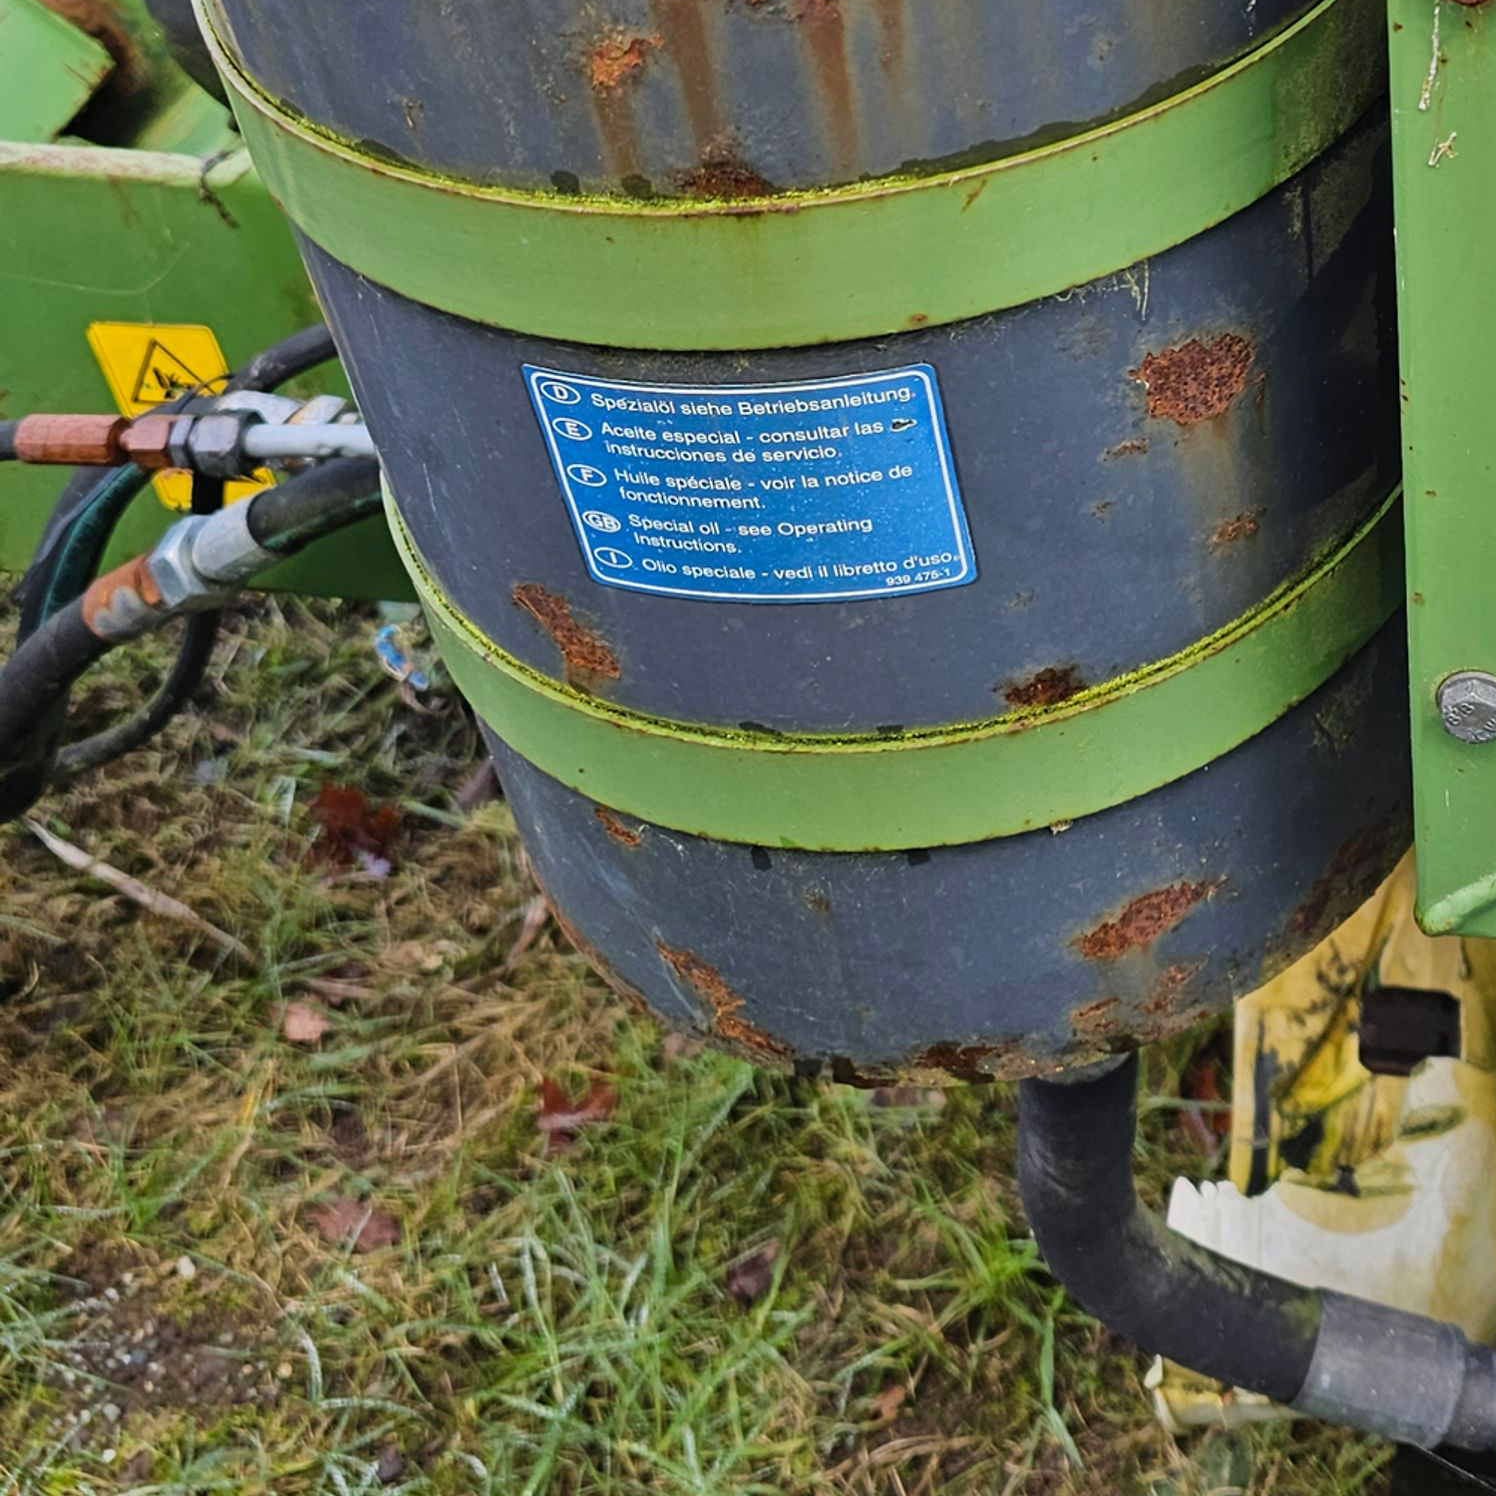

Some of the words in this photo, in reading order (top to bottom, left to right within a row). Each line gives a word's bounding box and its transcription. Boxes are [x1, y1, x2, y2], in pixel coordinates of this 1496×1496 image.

[552, 385, 568, 401] D
[590, 393, 676, 415] Spezialöl
[680, 401, 733, 416] siehe
[564, 423, 582, 438] E
[601, 421, 657, 441] Aceite
[662, 429, 741, 445] especial
[758, 425, 850, 444] consultar
[854, 421, 884, 435] las
[605, 440, 727, 464] instrucciones
[732, 449, 756, 464] de
[614, 467, 661, 486] Huile
[665, 475, 742, 491] spéciale
[760, 476, 796, 490] voir
[801, 474, 820, 489] la
[824, 469, 883, 487] notice
[888, 464, 914, 479] de
[619, 486, 766, 510] fonctionnement.
[627, 513, 694, 534] Special
[698, 521, 721, 535] oil
[737, 524, 772, 536] see
[777, 518, 874, 537] Operating
[633, 531, 742, 554] Instructions.
[641, 558, 678, 575] Olio
[682, 563, 756, 580] speciale
[774, 566, 813, 580] vedi
[818, 564, 829, 578] il
[832, 559, 898, 578] libretto
[885, 575, 911, 587] 939
